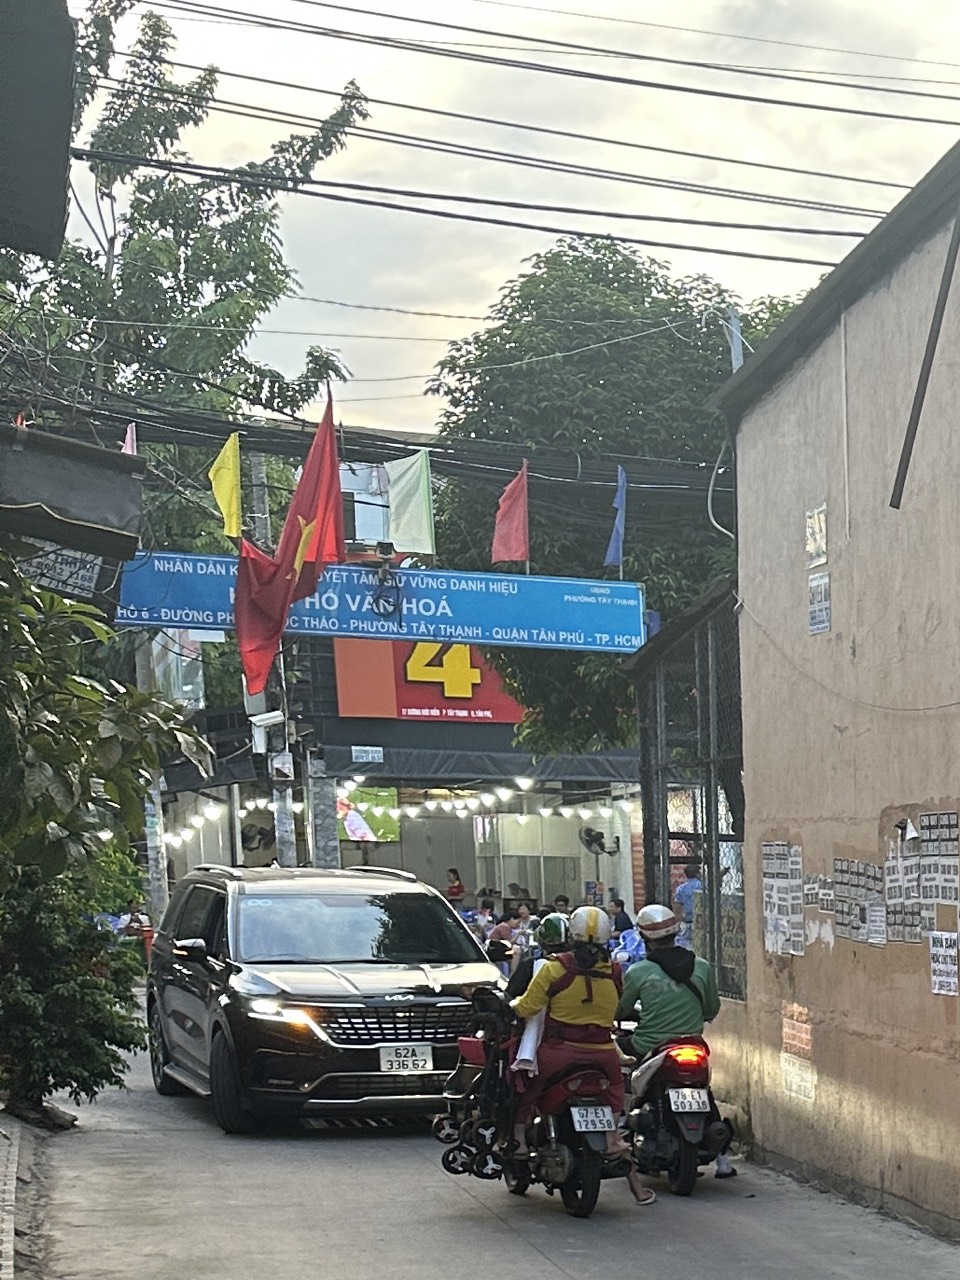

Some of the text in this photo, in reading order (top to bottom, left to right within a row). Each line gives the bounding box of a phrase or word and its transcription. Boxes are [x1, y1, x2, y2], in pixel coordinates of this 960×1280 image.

[154, 558, 194, 574] NHÂN
[197, 560, 228, 576] DÂN
[352, 569, 380, 586] TÂM
[409, 572, 448, 589] VỮNG
[450, 578, 486, 593] DANH
[489, 577, 518, 595] HIỆU
[142, 608, 149, 621] 6
[161, 607, 214, 623] ĐƯỜNG
[402, 594, 453, 617] HOÁ
[303, 617, 340, 630] THẢO
[351, 618, 407, 634] PHƯỜNG
[411, 622, 437, 636] TÂY
[439, 624, 482, 640] THẠNH
[493, 627, 528, 643] QUẬN
[531, 628, 556, 642] TÂN
[559, 631, 584, 644] PHÚ
[594, 634, 611, 646] TP.
[615, 635, 641, 647] HCM
[407, 642, 482, 698] 4
[394, 1047, 418, 1059] 62A
